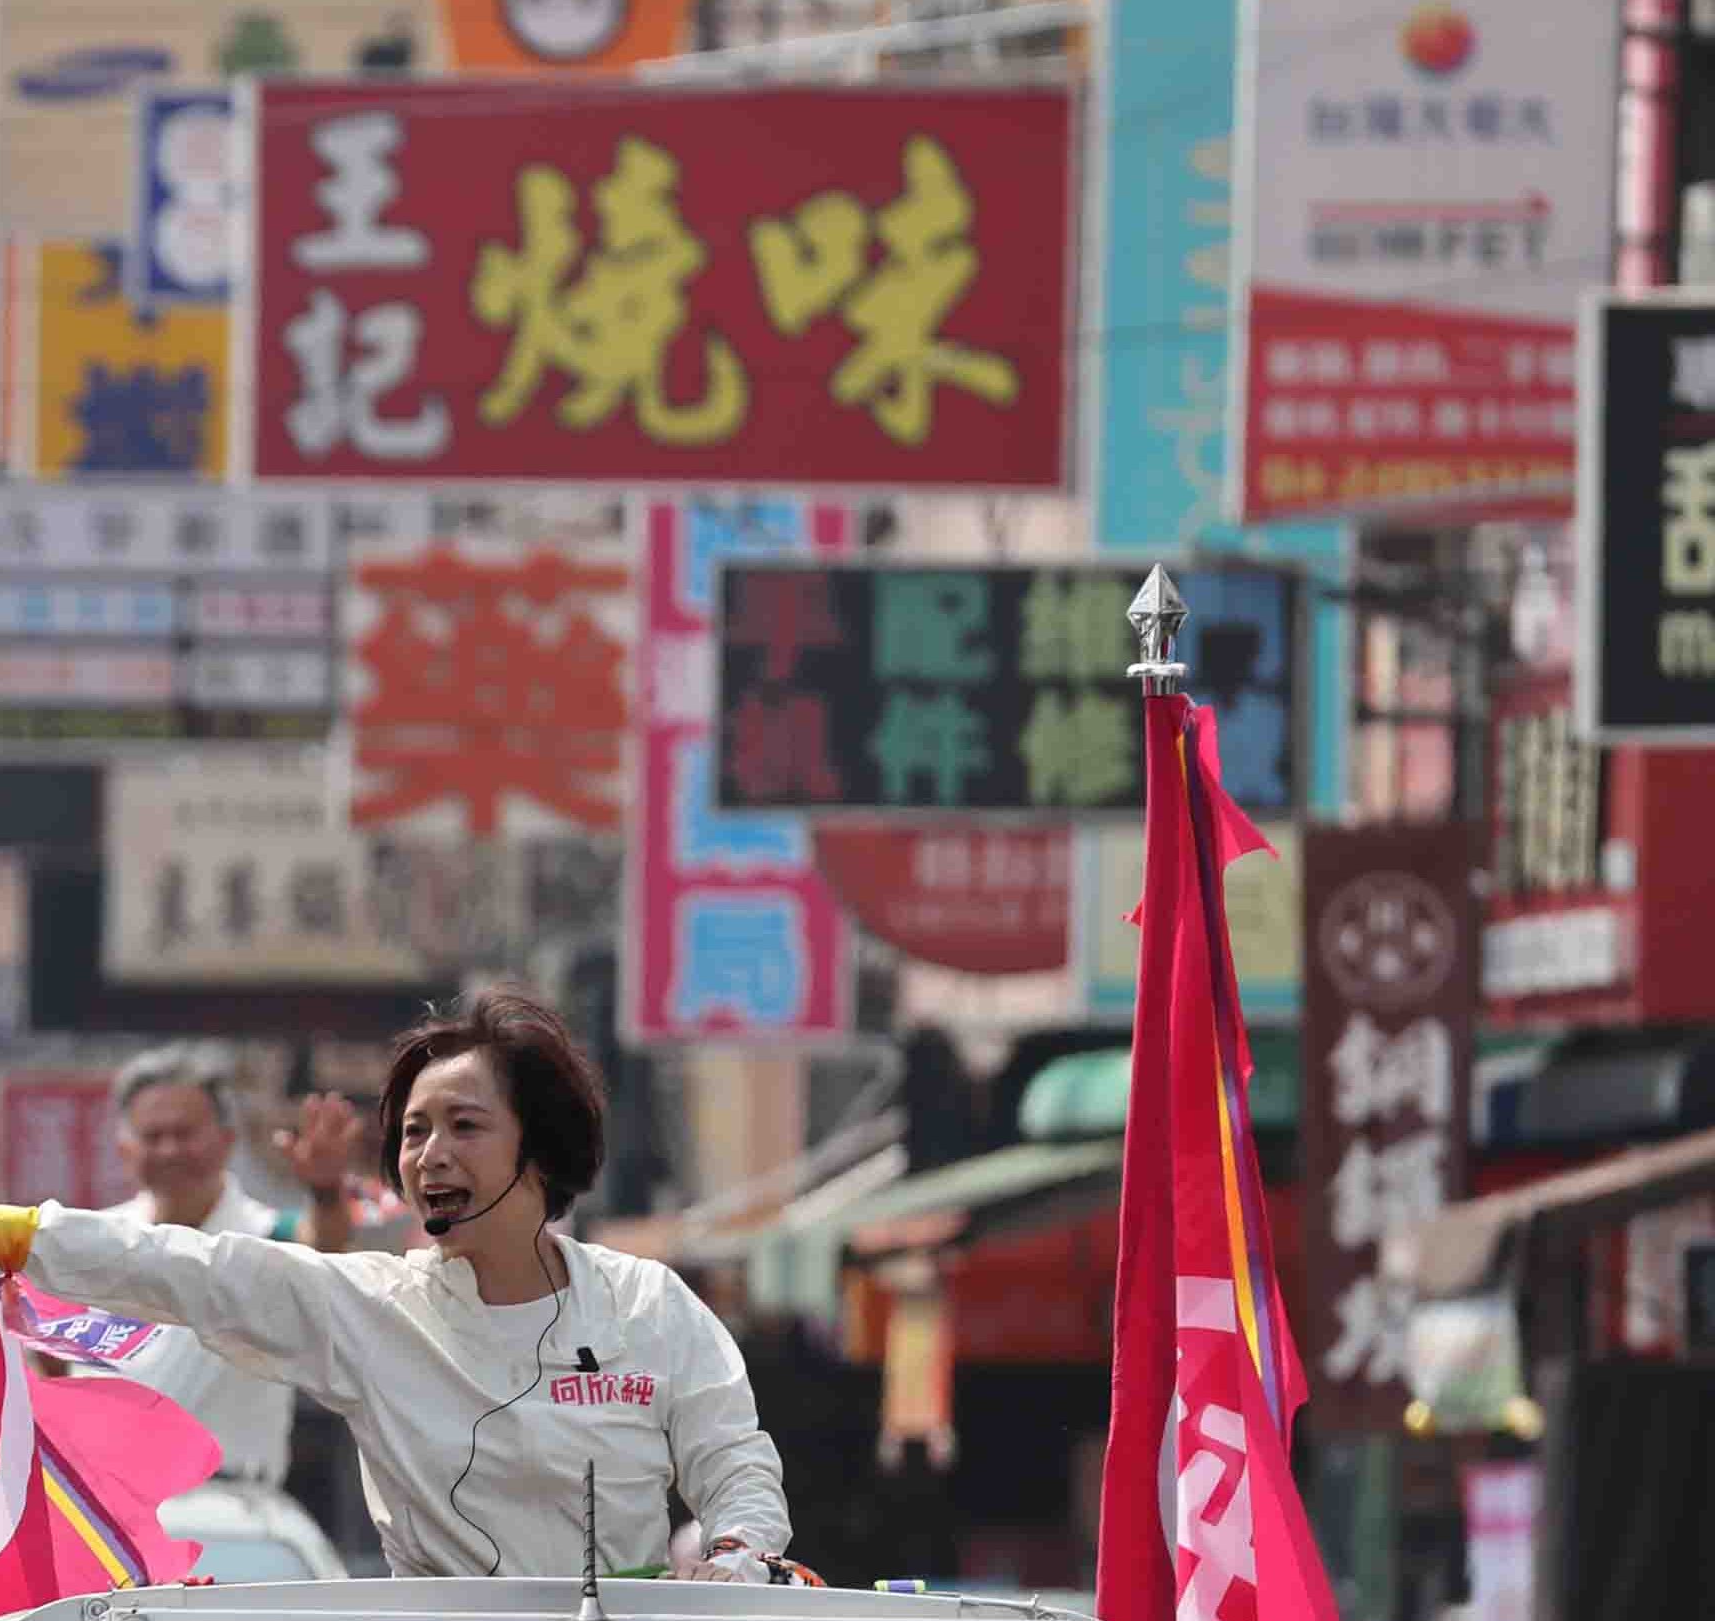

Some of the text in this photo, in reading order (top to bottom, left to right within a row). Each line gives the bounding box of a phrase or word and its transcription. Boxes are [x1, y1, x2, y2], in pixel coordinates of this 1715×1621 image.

[285, 109, 451, 458] 王記
[471, 133, 1021, 447] 燒味
[549, 1372, 655, 1407] 何欣純
